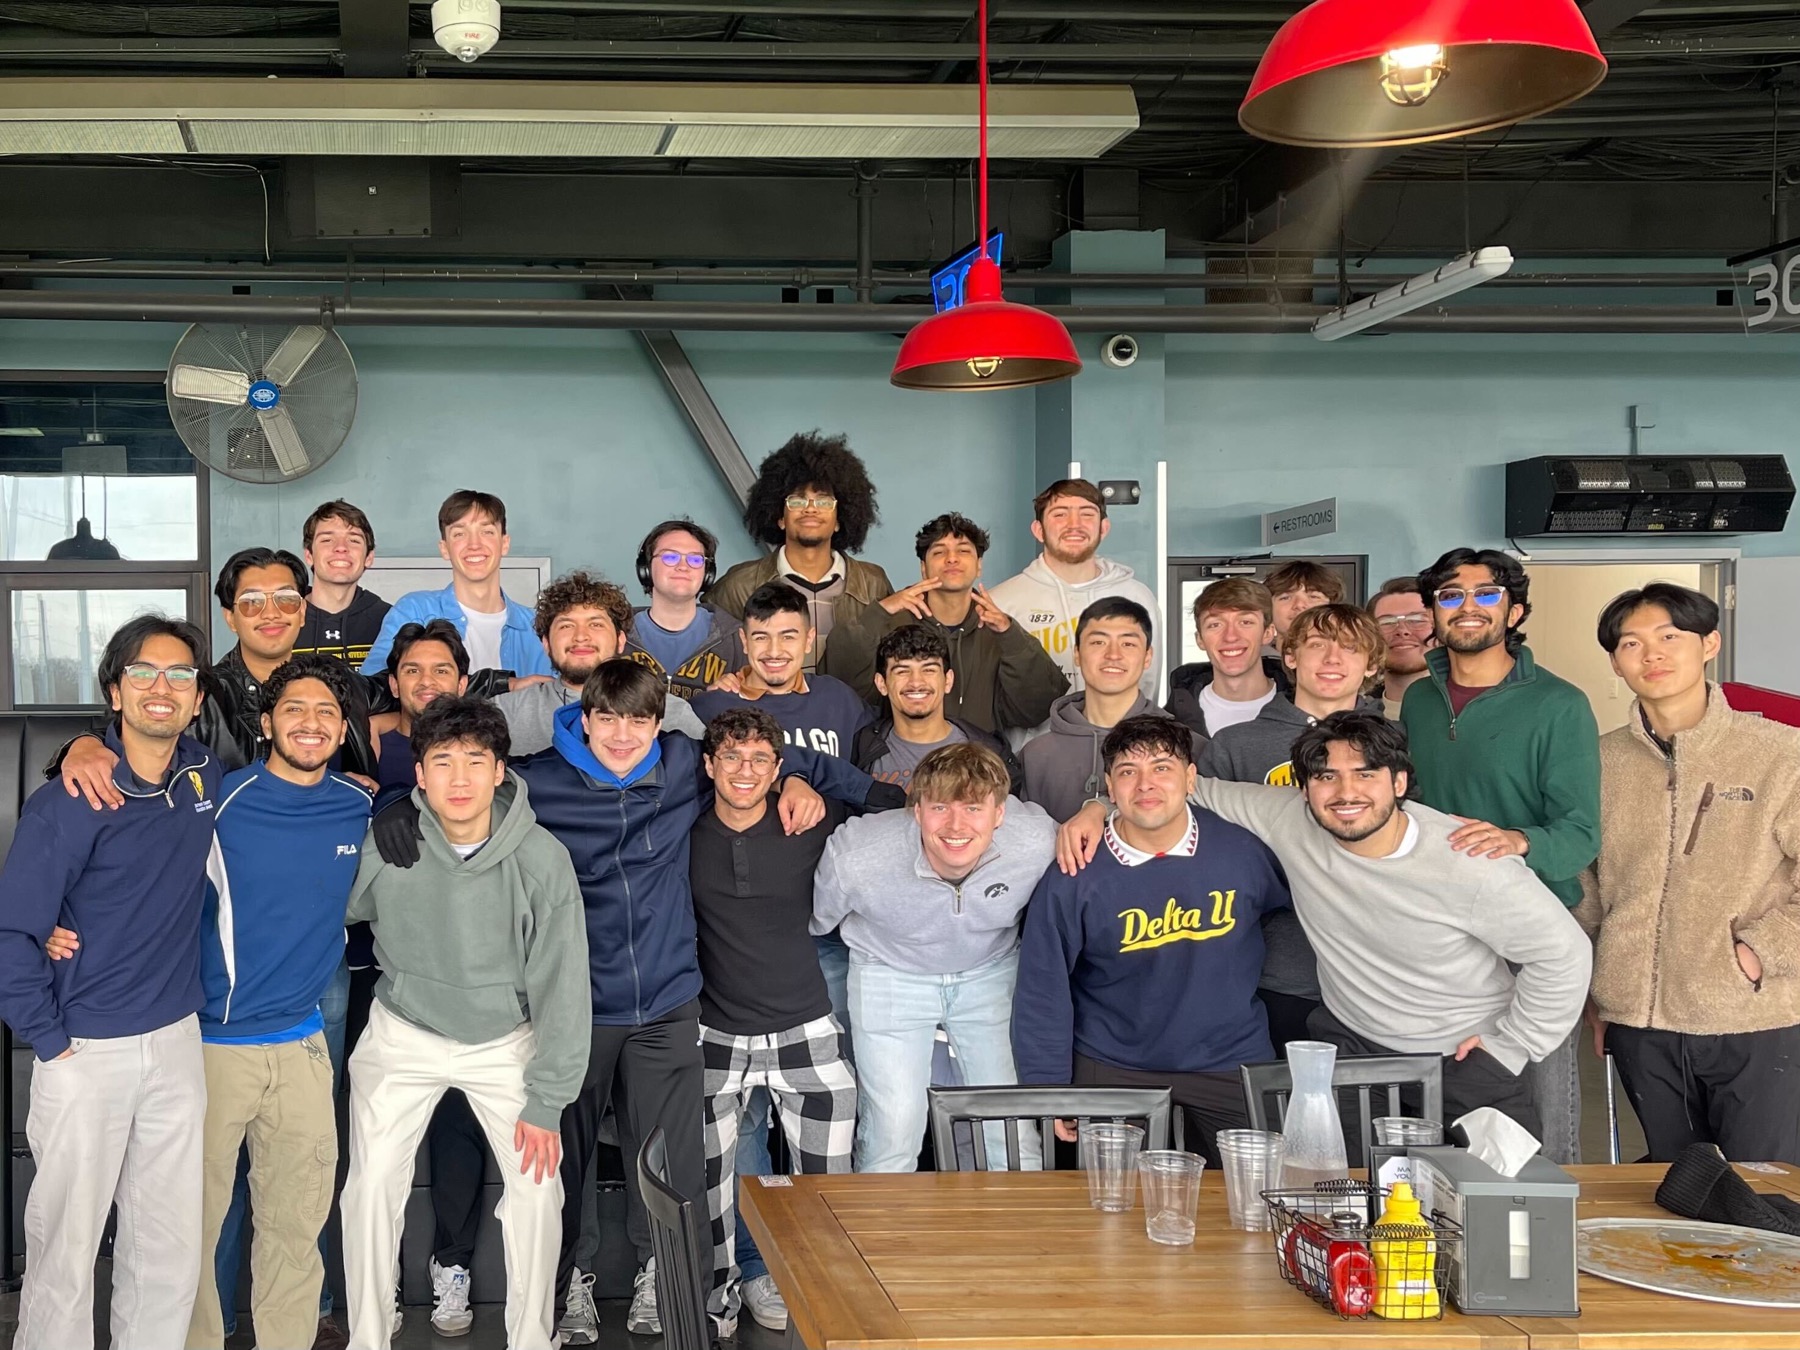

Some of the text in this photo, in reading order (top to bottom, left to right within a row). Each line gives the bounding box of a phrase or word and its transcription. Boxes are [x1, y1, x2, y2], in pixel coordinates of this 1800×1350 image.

[1281, 509, 1333, 532] RESTROOMS
[1029, 614, 1055, 623] 1837
[336, 843, 357, 855] FILA
[1117, 889, 1236, 945] Delta U
